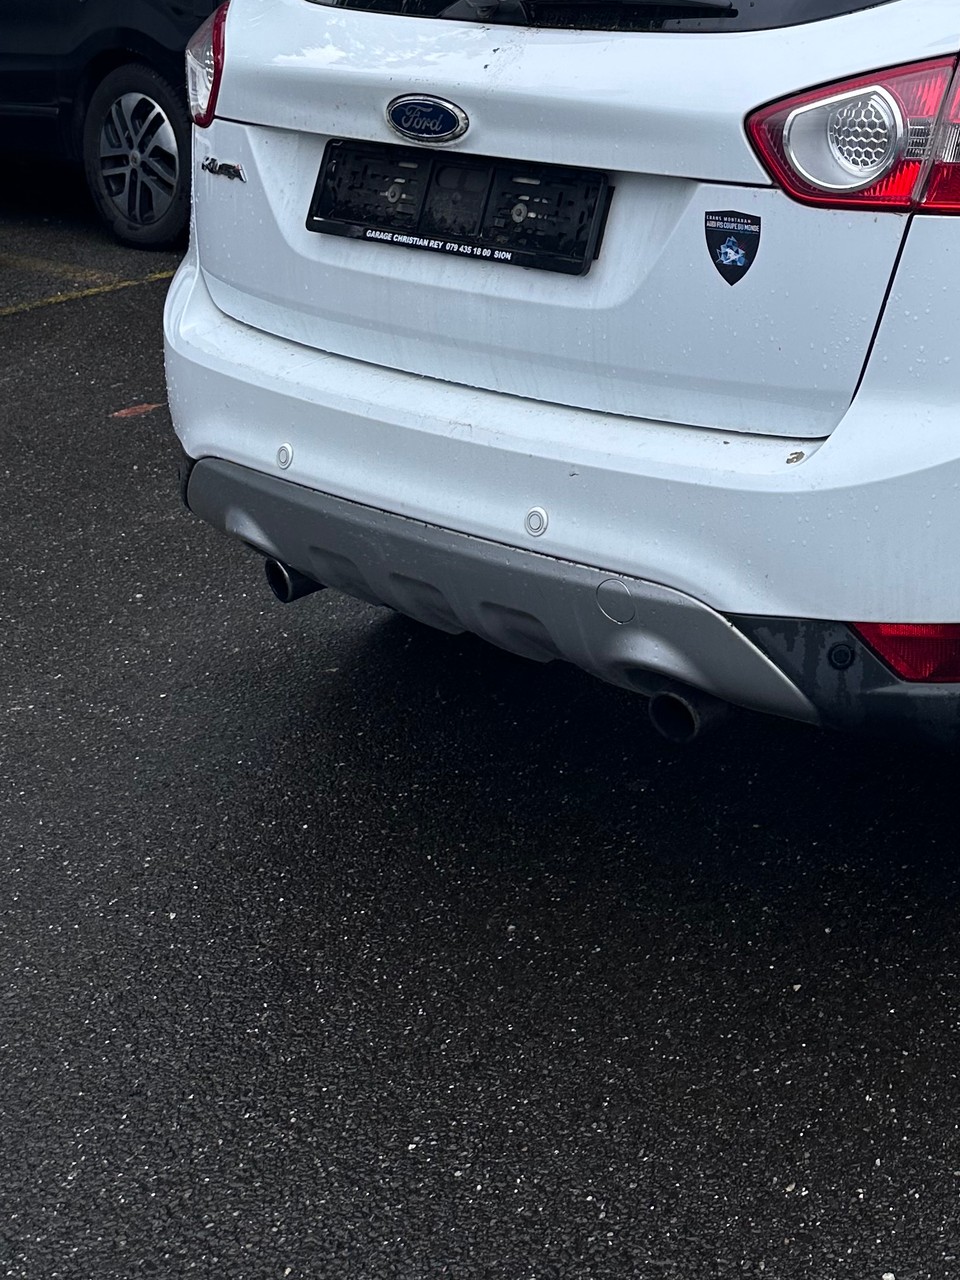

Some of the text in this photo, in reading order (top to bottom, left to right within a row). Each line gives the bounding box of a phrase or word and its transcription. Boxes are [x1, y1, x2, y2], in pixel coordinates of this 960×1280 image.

[400, 104, 444, 131] Ford
[366, 229, 393, 241] GARAGE
[393, 234, 429, 247] CHRISTIAN
[429, 239, 444, 249] REY
[445, 242, 459, 251] 079
[459, 244, 473, 254] 435
[473, 247, 482, 255] 18
[493, 250, 512, 260] SION
